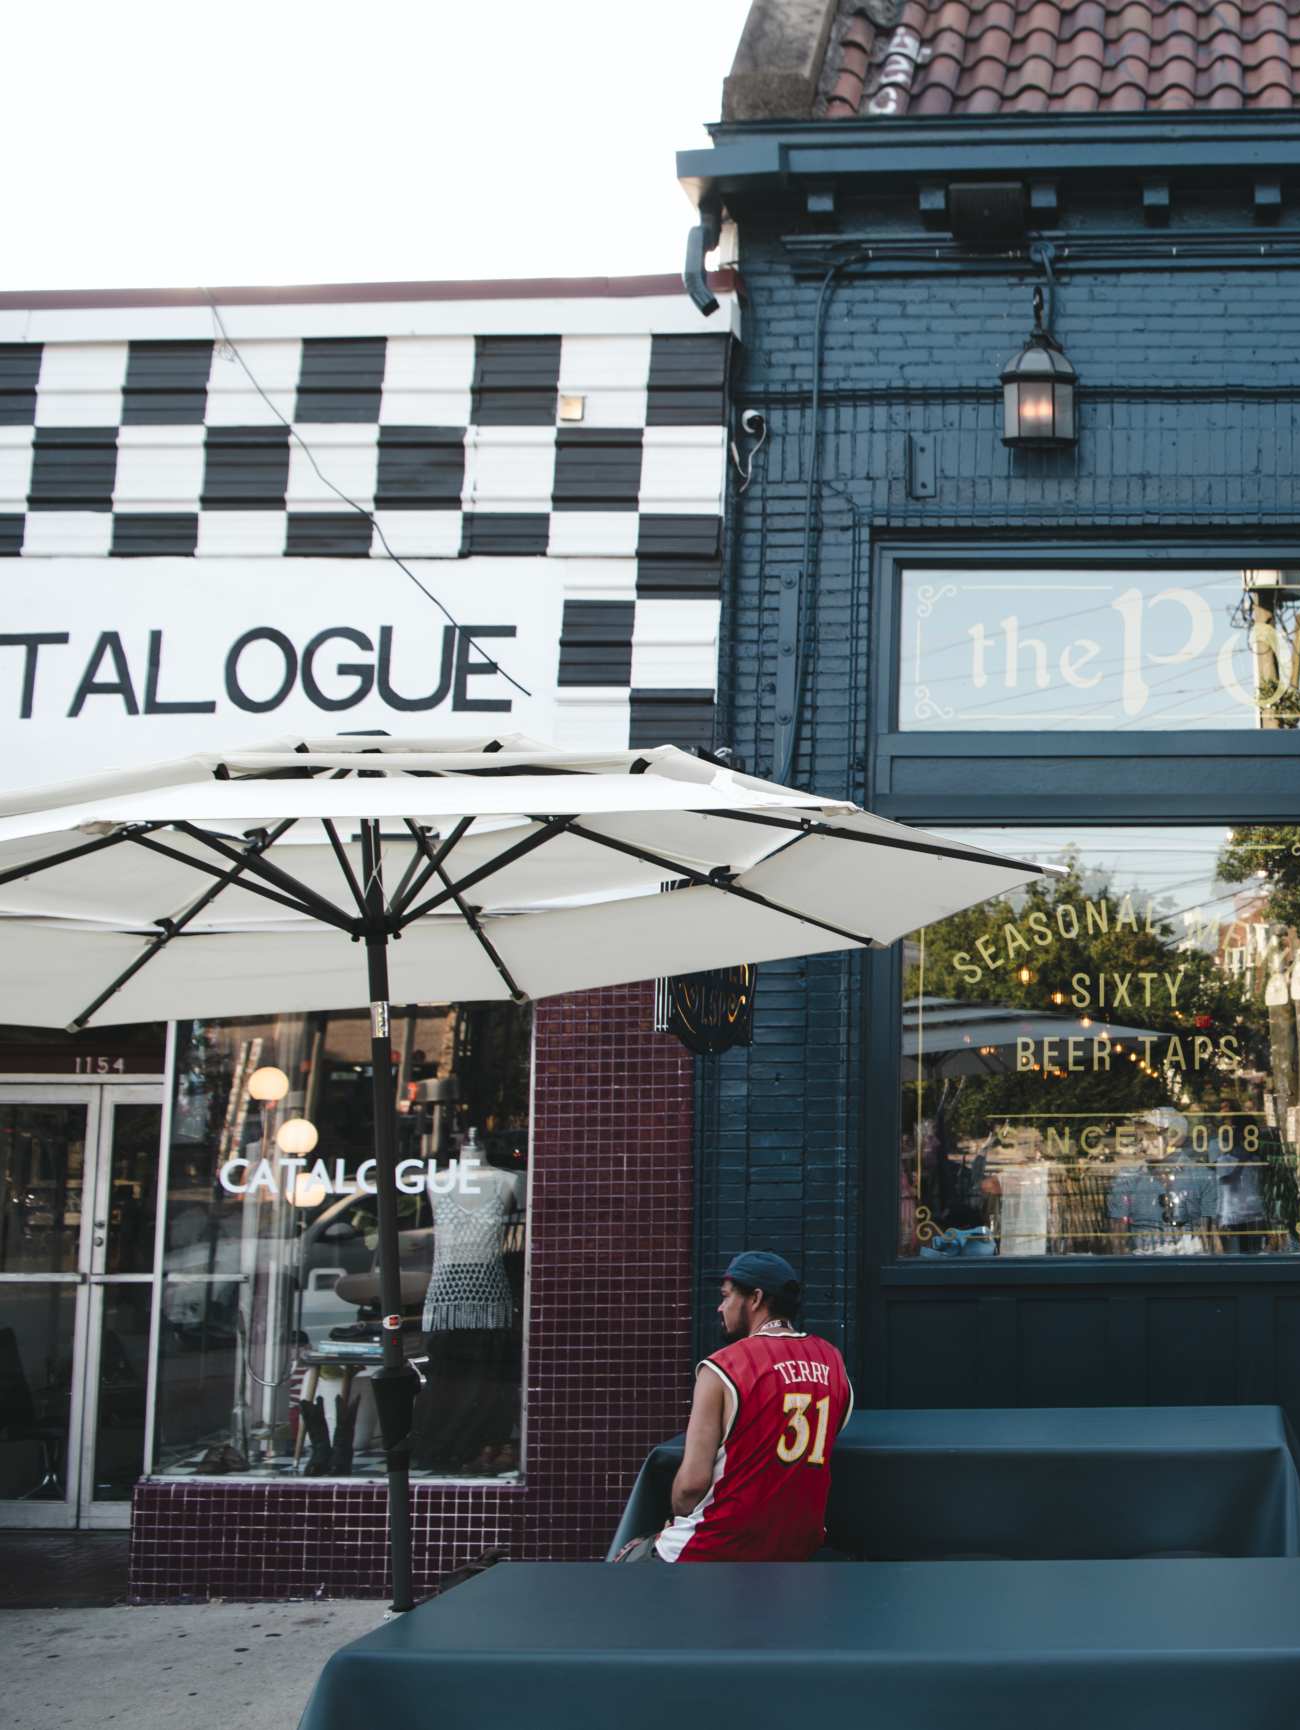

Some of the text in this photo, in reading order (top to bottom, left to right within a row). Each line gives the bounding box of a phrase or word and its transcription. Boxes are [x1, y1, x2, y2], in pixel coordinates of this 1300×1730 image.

[968, 615, 1103, 688] the
[0, 624, 518, 719] TALOGUE
[952, 895, 1162, 984] SEASONAL
[1072, 972, 1185, 1008] SIXTY
[75, 1056, 124, 1073] 1154
[1016, 1036, 1240, 1072] BEER TAPS
[1167, 1123, 1260, 1152] 2008
[774, 1361, 831, 1386] TERRY
[776, 1392, 831, 1467] 31
